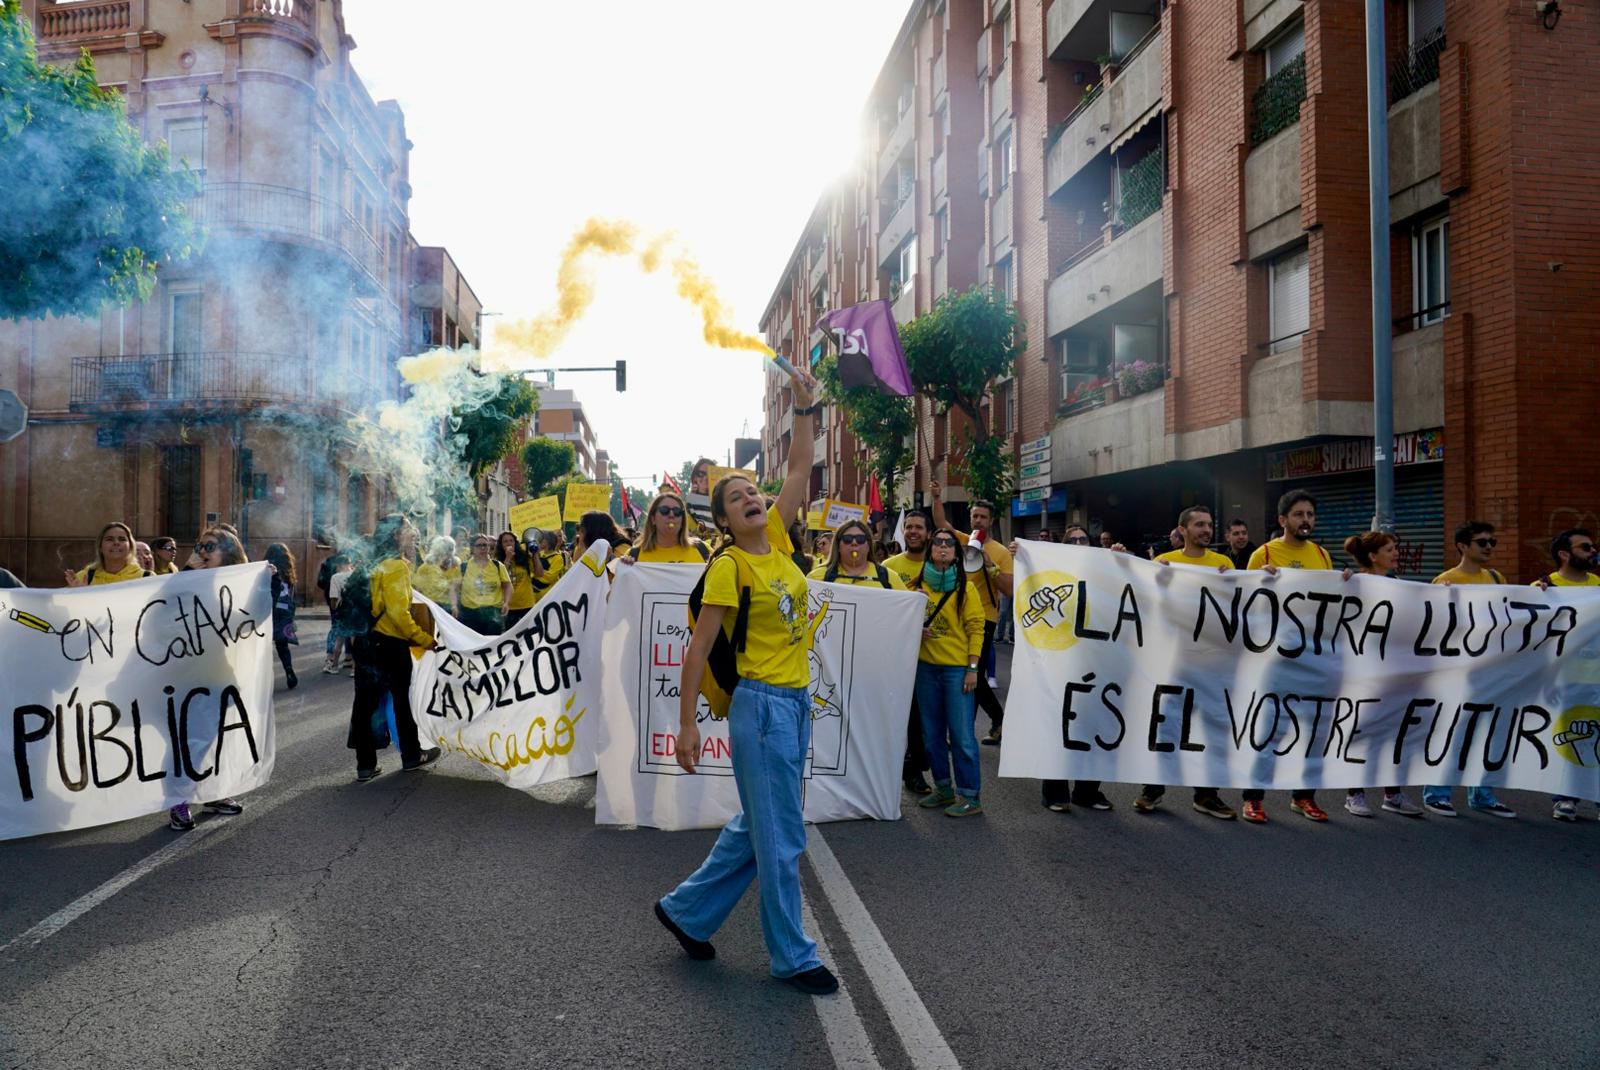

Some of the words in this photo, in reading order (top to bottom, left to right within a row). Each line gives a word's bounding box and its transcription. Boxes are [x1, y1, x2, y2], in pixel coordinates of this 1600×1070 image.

[657, 619, 683, 635] Les
[1074, 580, 1143, 647] LA
[1193, 586, 1394, 661] NOSTRA
[426, 679, 463, 720] LA
[1062, 672, 1126, 751] ÉS
[1148, 684, 1205, 752] EL
[1224, 688, 1381, 765] VOSTRE
[1393, 698, 1551, 771] FUTUR
